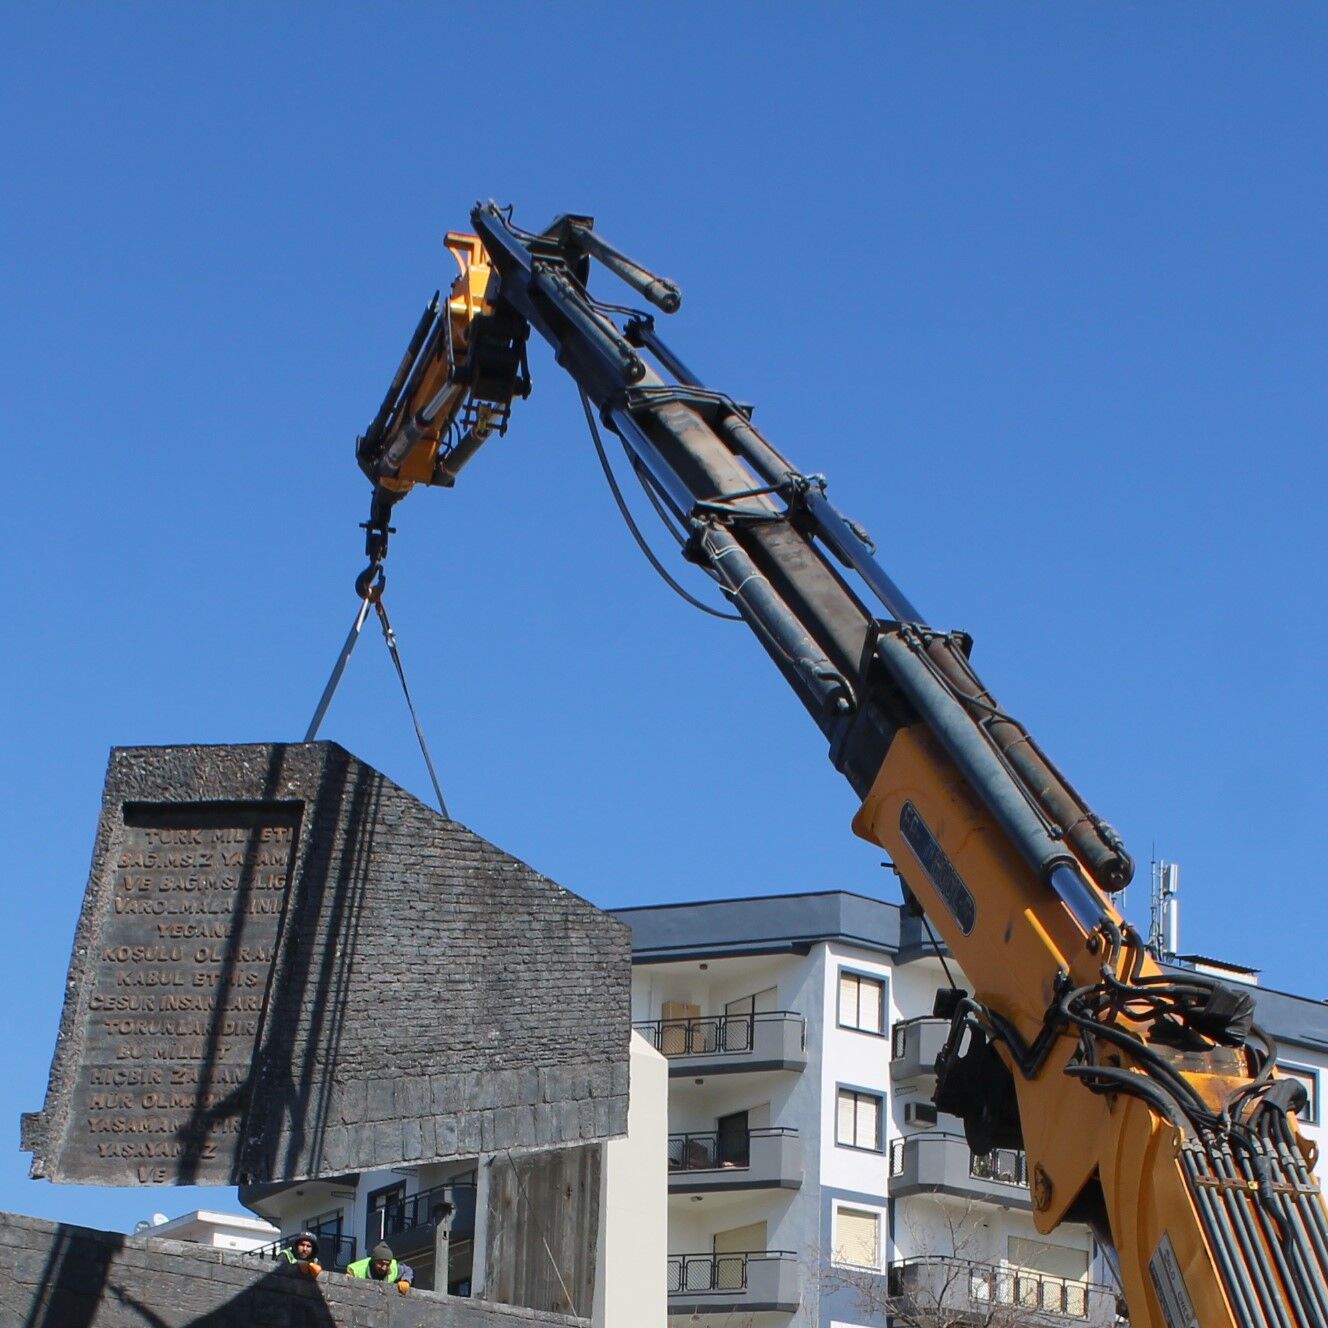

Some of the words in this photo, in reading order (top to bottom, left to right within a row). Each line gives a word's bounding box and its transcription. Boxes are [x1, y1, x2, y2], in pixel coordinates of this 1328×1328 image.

[123, 875, 153, 892] VE
[101, 945, 183, 964] KOŞULU
[194, 946, 274, 964] OLRAK
[116, 970, 184, 987] KABUL
[88, 995, 155, 1012] CESUR
[137, 1166, 167, 1184] VE
